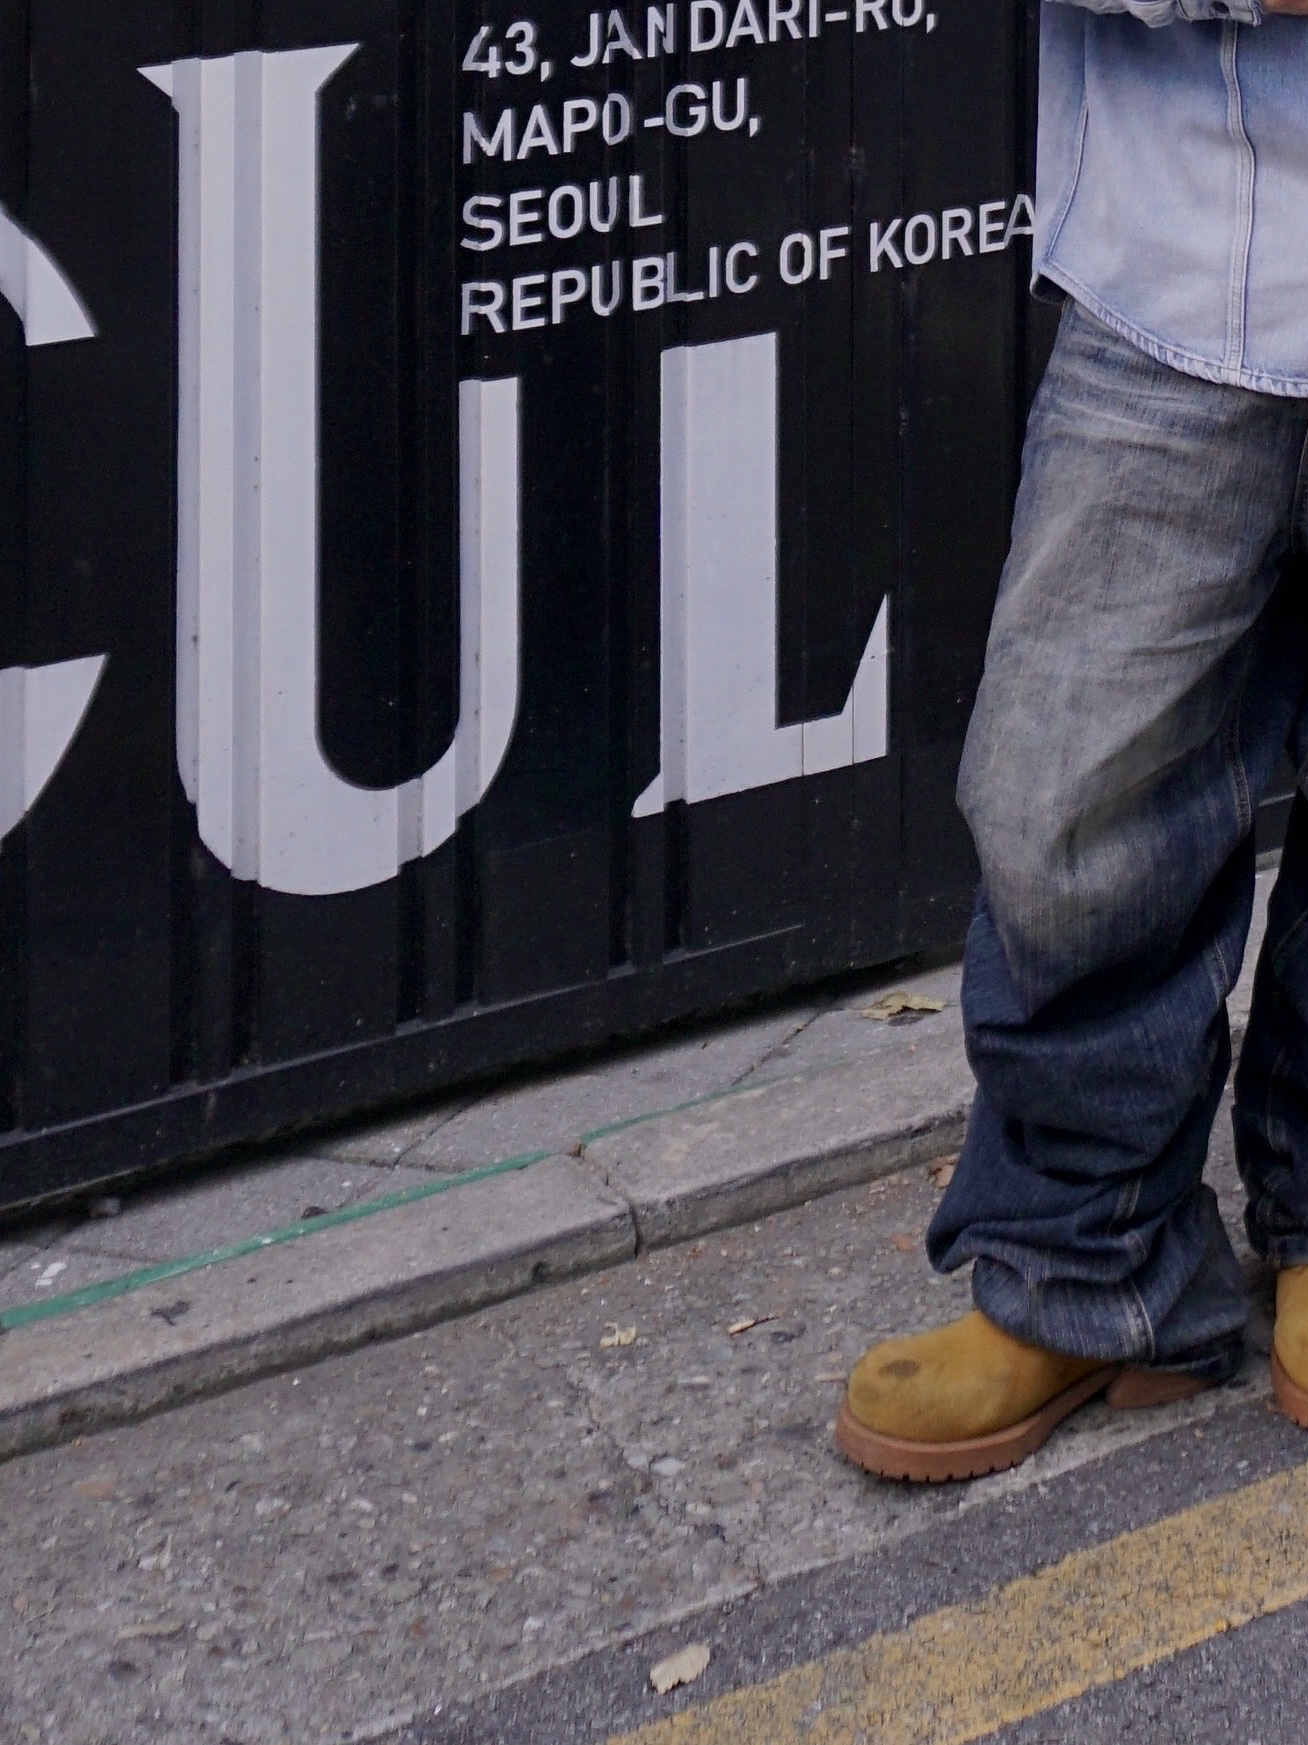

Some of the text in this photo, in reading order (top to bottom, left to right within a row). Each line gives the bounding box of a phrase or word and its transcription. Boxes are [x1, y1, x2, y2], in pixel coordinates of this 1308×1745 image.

[462, 21, 552, 82] 43,
[463, 77, 760, 164] MAPO-GU,
[460, 174, 663, 252] SEOUL
[460, 194, 1036, 336] REPUBLIC OF KOREA
